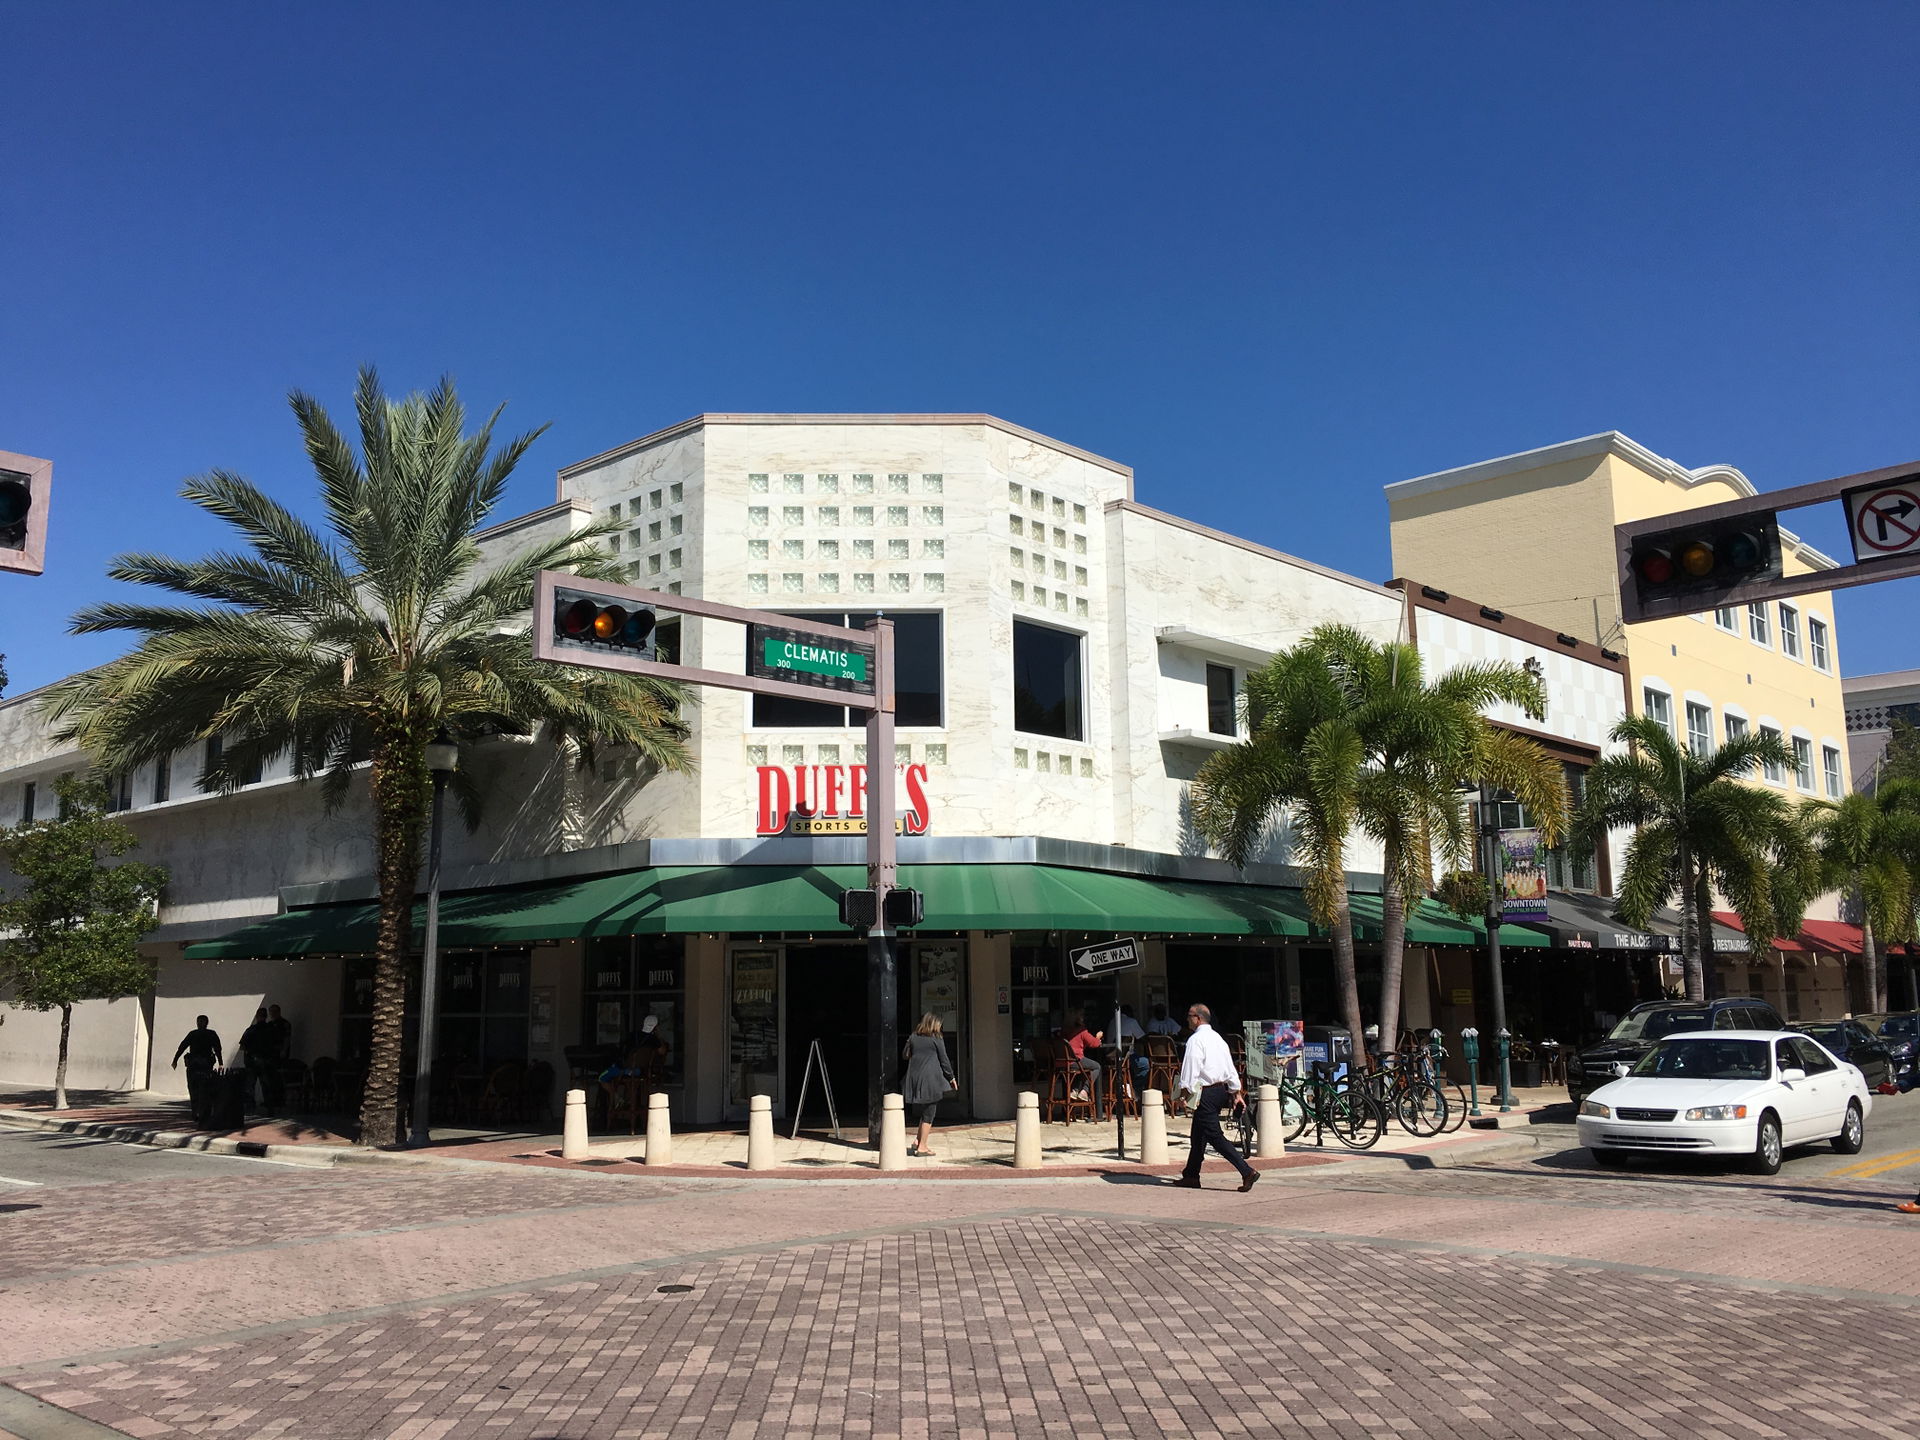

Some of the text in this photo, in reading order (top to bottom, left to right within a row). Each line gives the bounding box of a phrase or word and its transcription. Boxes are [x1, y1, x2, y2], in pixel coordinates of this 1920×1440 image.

[784, 643, 848, 667] CLEMATIS
[776, 659, 791, 669] 300
[842, 670, 856, 680] 200
[756, 763, 930, 834] DUFF'S
[795, 822, 850, 831] SPORTS
[1503, 899, 1547, 908] DOWNTOWN
[1614, 934, 1629, 947] THE
[1091, 947, 1131, 965] ONE WAY
